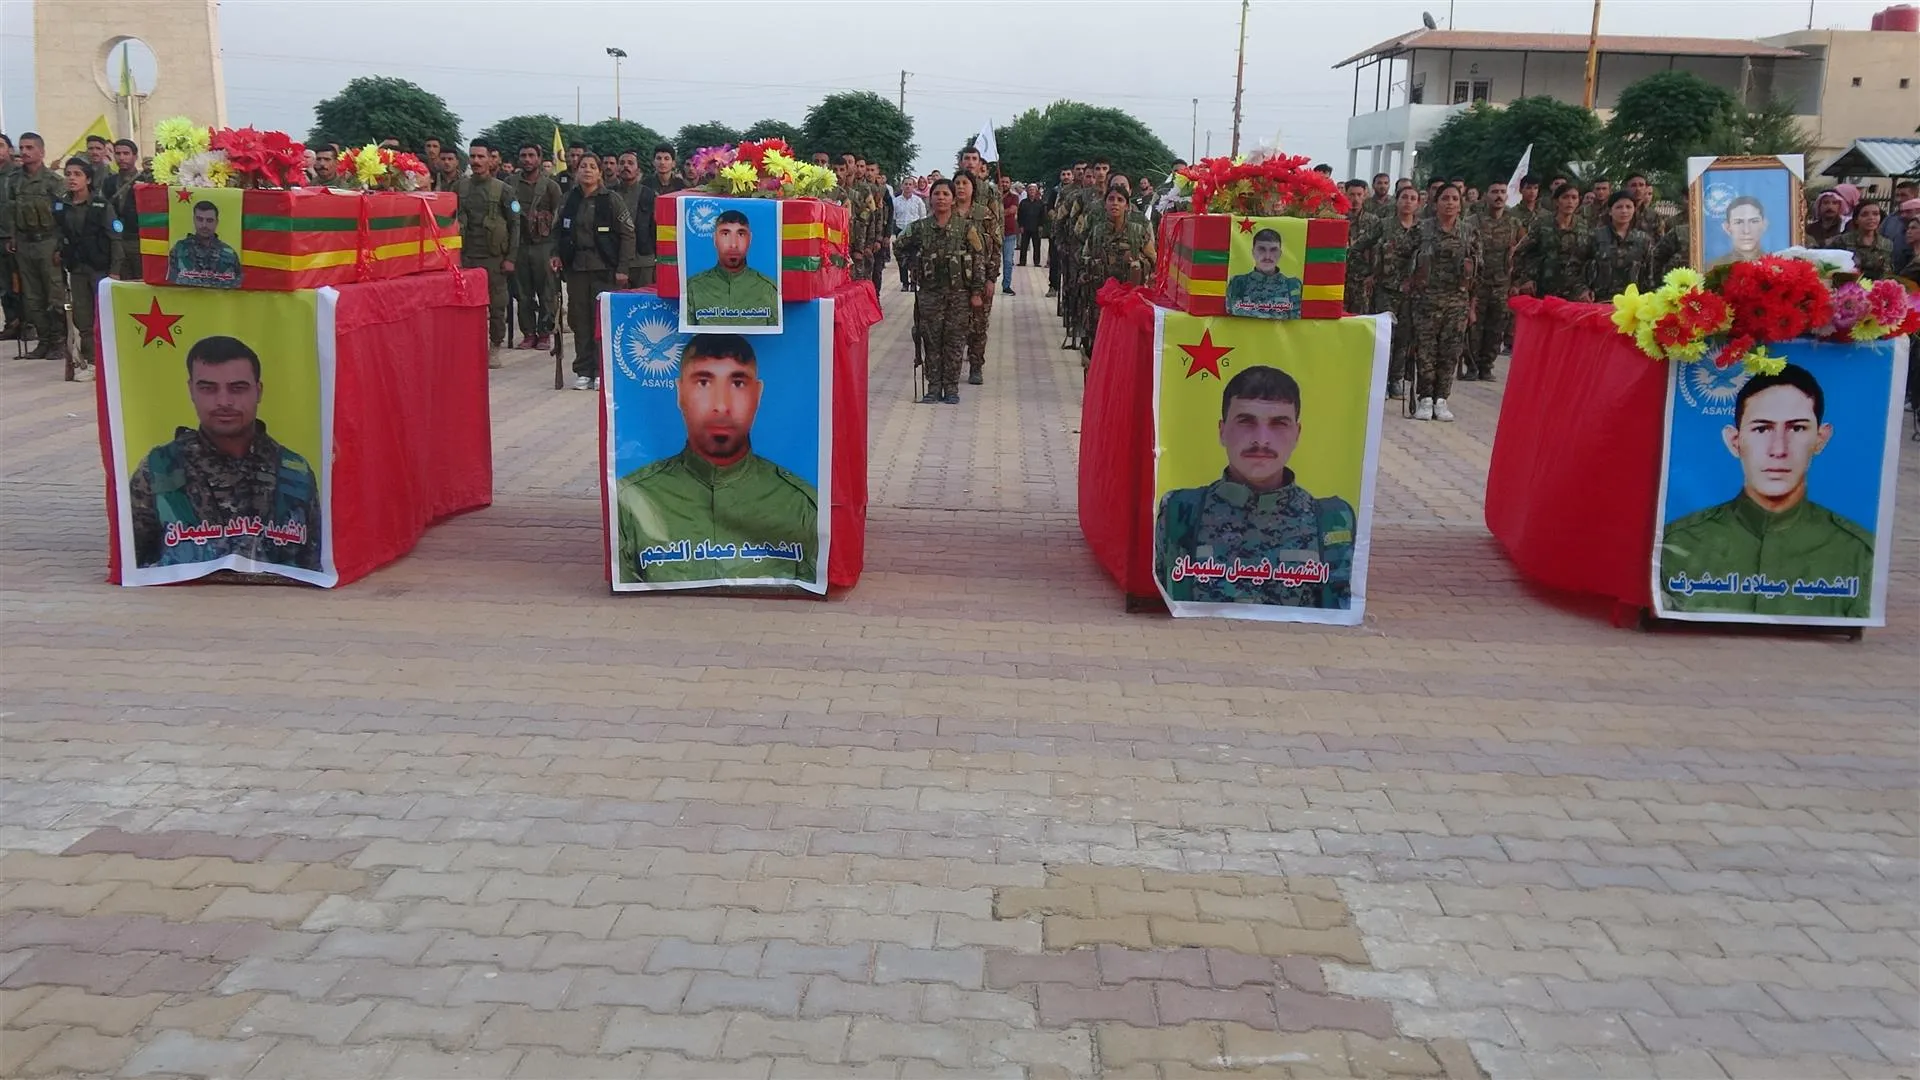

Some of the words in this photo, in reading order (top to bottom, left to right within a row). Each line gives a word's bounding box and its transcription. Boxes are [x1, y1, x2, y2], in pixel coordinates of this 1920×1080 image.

[164, 520, 223, 547] سليمان
[224, 516, 264, 537] خالد
[265, 519, 307, 545] الشهيد
[640, 539, 691, 570] النجم
[694, 538, 737, 560] عماد
[740, 541, 803, 563] الشهيد
[1171, 555, 1227, 583] سليمان
[1226, 557, 1273, 585] فيصل
[1272, 559, 1330, 588] الشهيد
[1668, 571, 1739, 596] المشرف
[1741, 573, 1789, 598] ميلاد
[1791, 576, 1860, 600] الشهيد
